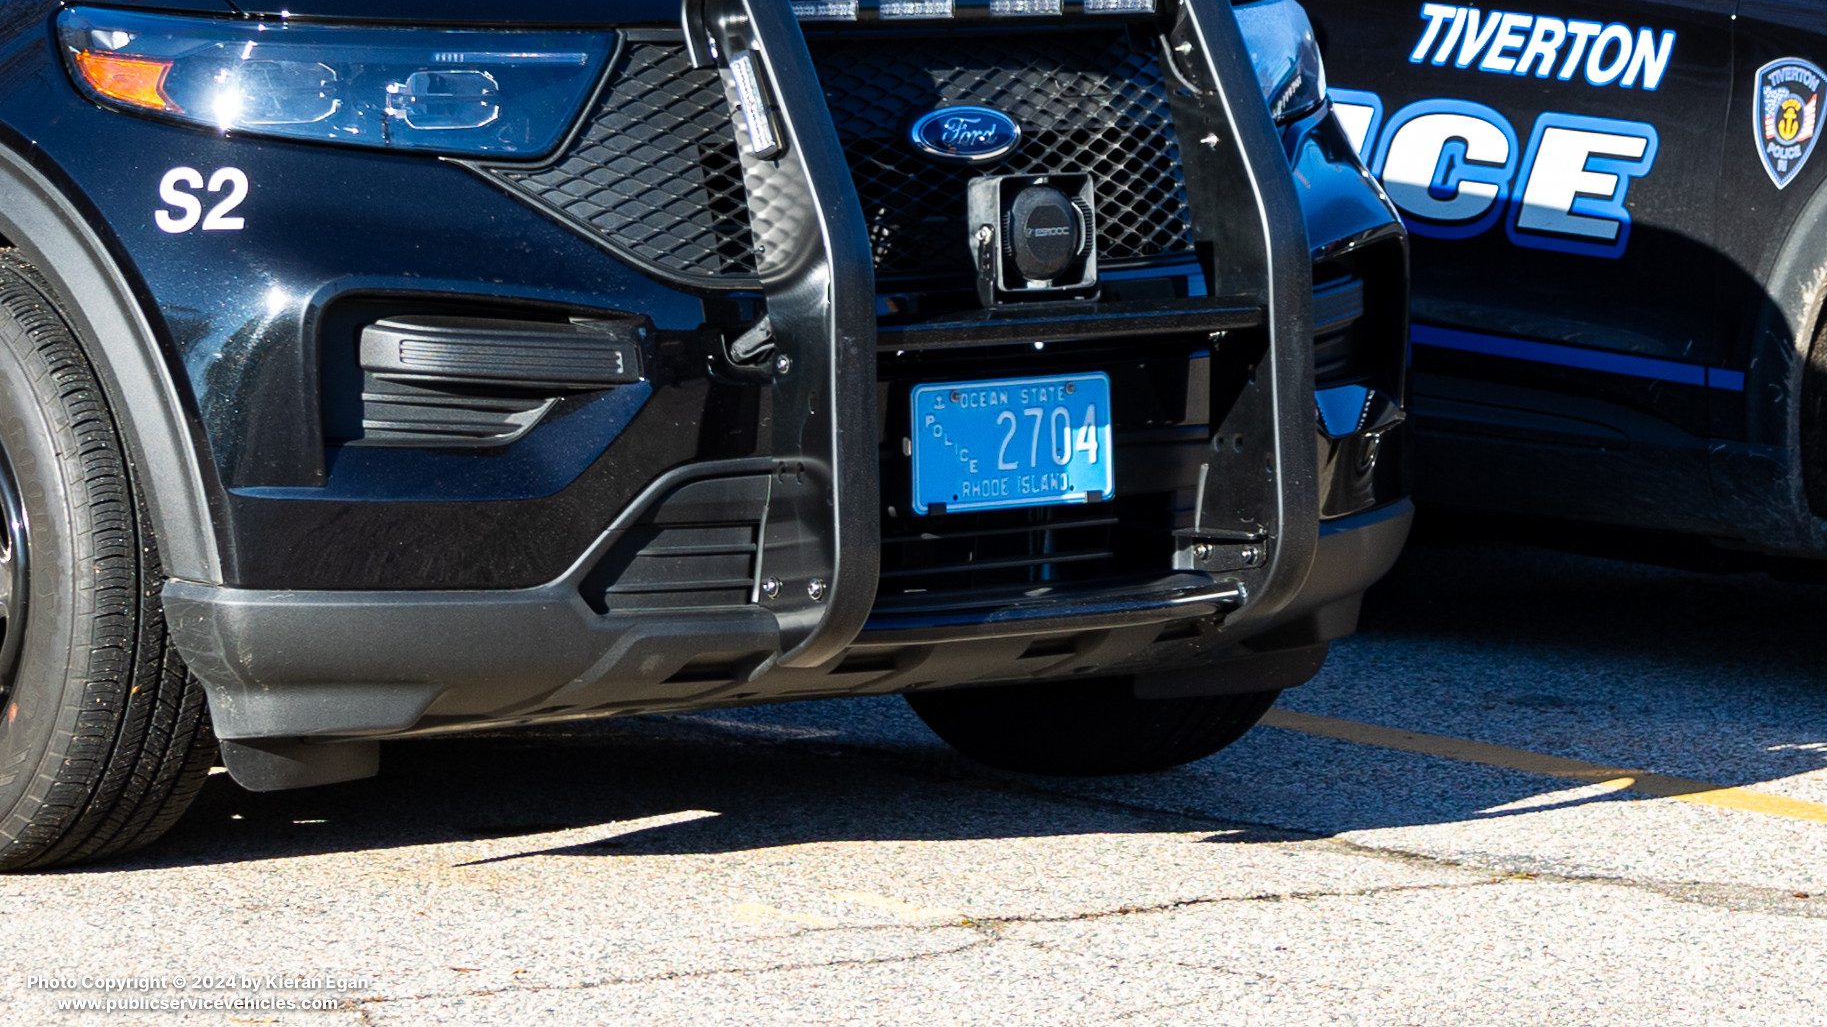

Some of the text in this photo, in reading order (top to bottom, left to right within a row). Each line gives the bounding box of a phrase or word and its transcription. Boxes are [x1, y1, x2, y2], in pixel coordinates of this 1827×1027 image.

[1409, 3, 1676, 91] TIVERTON
[1767, 66, 1820, 92] TIVERTON
[942, 116, 997, 147] Ford
[1766, 141, 1802, 160] POLICE
[154, 166, 249, 234] S2
[960, 385, 1065, 409] OCEAN STATE
[925, 415, 979, 473] POLICE
[996, 404, 1099, 471] 2704
[962, 472, 1069, 499] RHODE ISLAND
